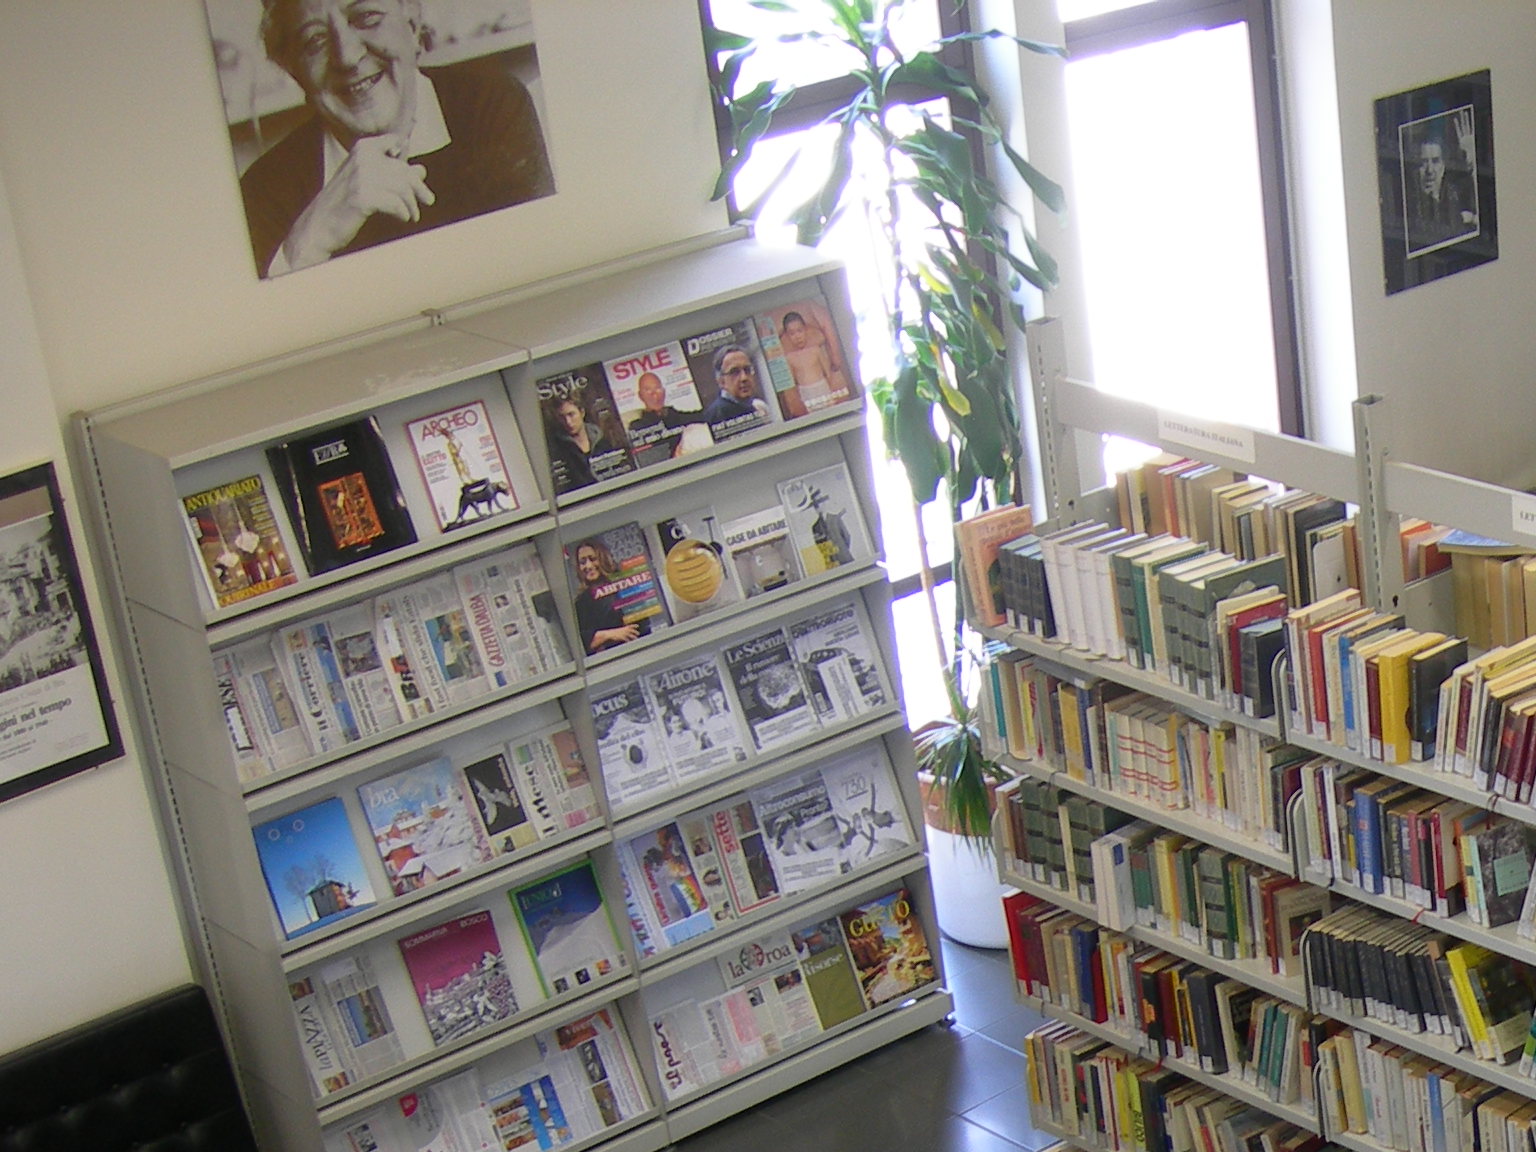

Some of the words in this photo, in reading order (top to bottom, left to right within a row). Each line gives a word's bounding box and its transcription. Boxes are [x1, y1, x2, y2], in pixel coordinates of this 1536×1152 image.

[612, 349, 673, 381] STYLE
[537, 374, 589, 401] Style
[421, 408, 479, 441] ARCHEO
[183, 476, 262, 512] ANTIQUARIATO
[726, 531, 748, 546] CASE
[758, 520, 788, 538] ABITARE
[594, 571, 652, 600] ABITARE
[656, 660, 715, 692] Airone
[39, 697, 73, 717] tempo
[841, 776, 867, 797] 730
[714, 811, 740, 854] sette
[459, 913, 489, 930] BOSCO
[802, 951, 844, 977] Risorse
